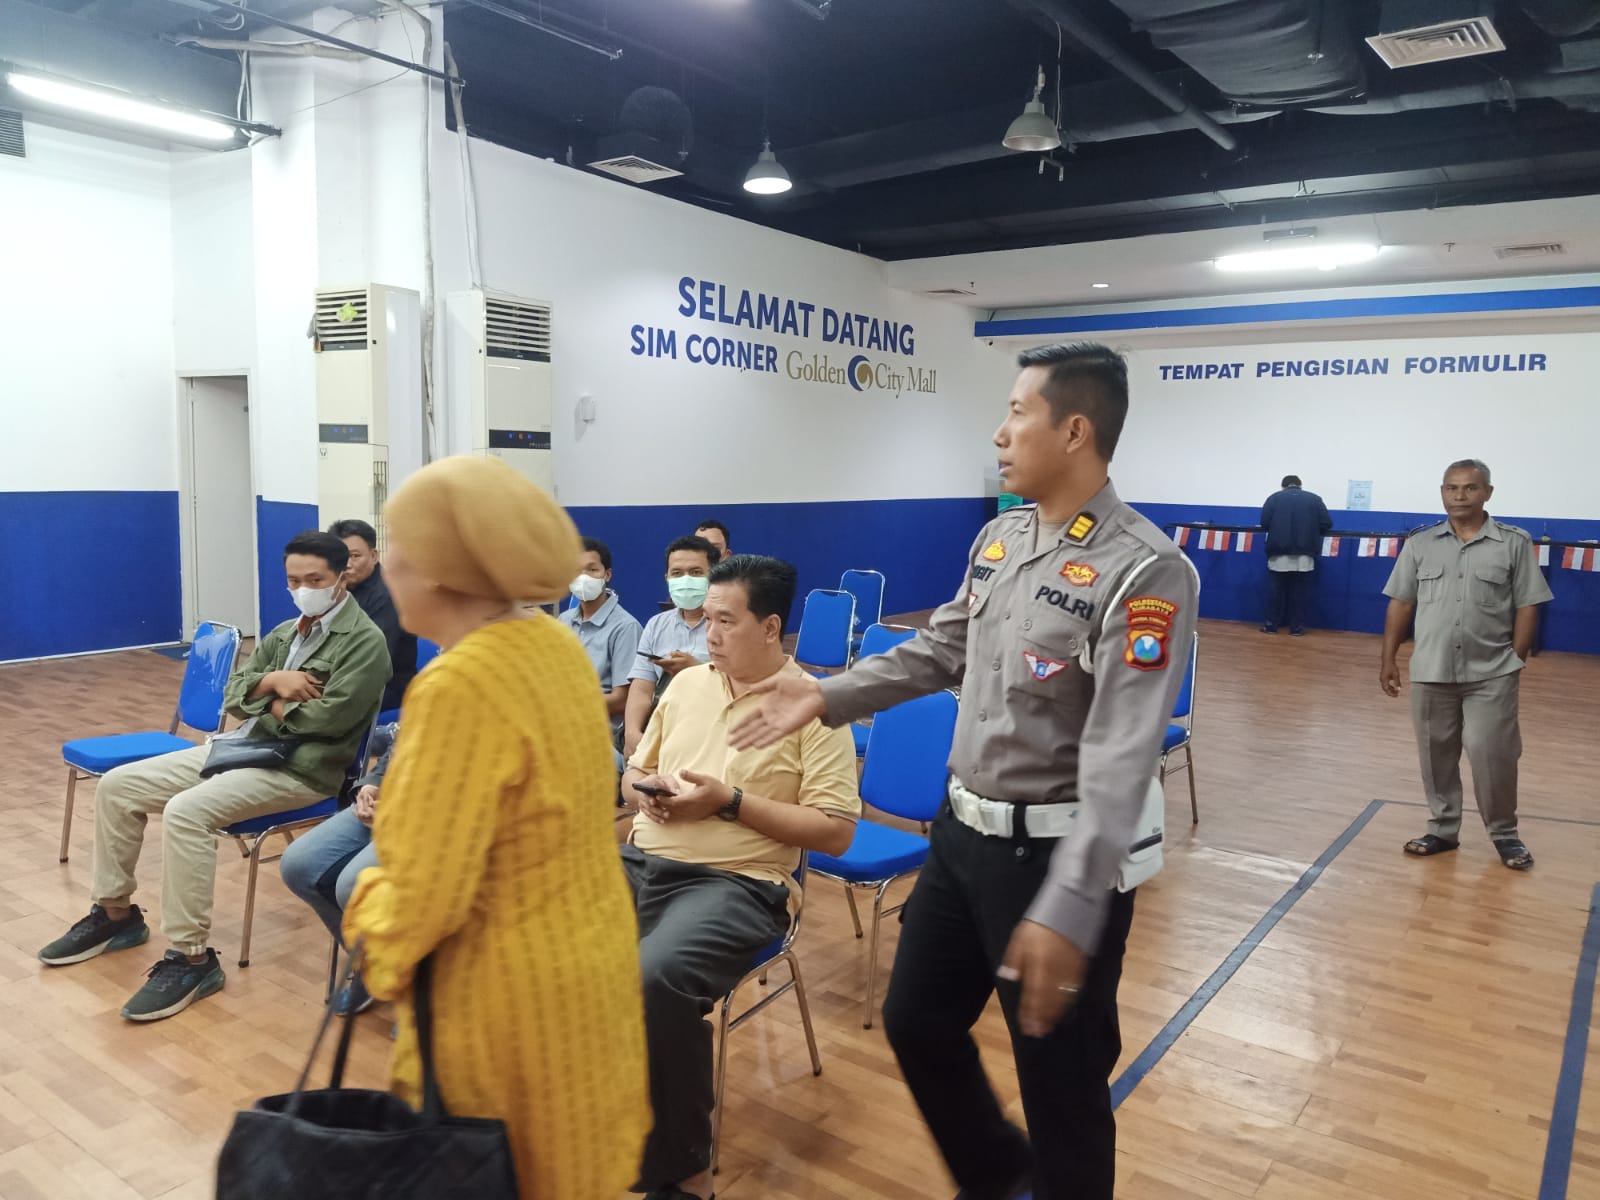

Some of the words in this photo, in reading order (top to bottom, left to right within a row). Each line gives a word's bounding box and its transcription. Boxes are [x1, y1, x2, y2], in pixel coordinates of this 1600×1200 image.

[678, 276, 815, 338] SELAMAT
[823, 307, 914, 355] DATANG
[630, 324, 677, 359] SIM
[685, 334, 778, 373] CORNER
[1159, 363, 1245, 380] TEMPAT
[1256, 357, 1389, 378] PENGISIAN
[1404, 353, 1547, 374] FORMULIR
[786, 351, 846, 385] Golden
[874, 363, 905, 398] City
[906, 367, 937, 393] Mall
[1034, 585, 1096, 621] POLRI
